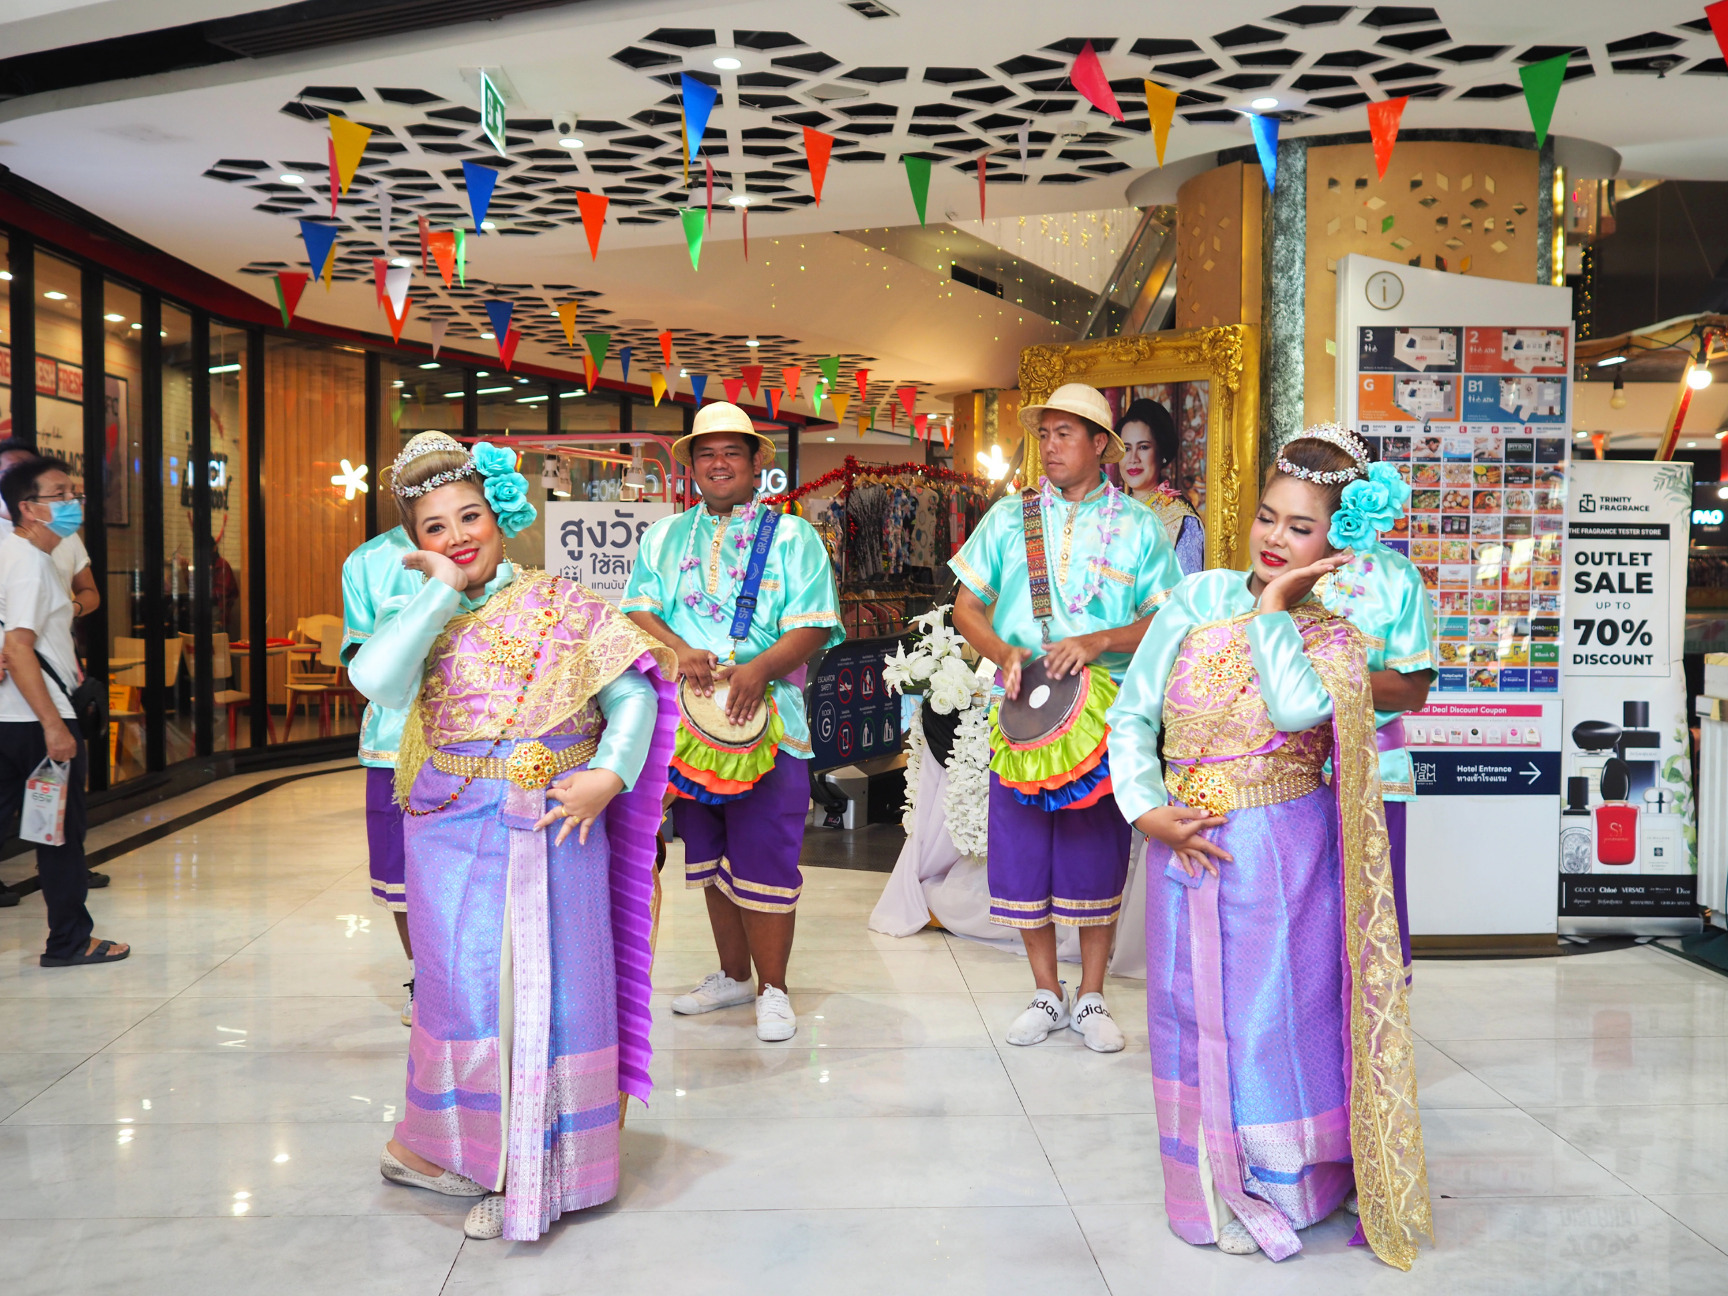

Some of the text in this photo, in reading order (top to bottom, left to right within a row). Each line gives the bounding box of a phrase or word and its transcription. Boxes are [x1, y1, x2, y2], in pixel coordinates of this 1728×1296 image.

[1364, 329, 1374, 342] 3
[1469, 331, 1479, 343] 2
[1363, 378, 1375, 391] G
[1467, 380, 1483, 393] B1
[1599, 504, 1650, 512] FRAGRANCE
[1693, 509, 1724, 525] PAO
[1581, 527, 1617, 535] FRAGRANCE
[1641, 528, 1661, 536] STORE
[756, 525, 772, 554] GRAND
[1574, 551, 1653, 566] OUTLET
[1574, 571, 1653, 594] SALE
[1595, 601, 1631, 610] UP TO
[1573, 618, 1653, 646] 70%
[1573, 654, 1654, 665] DISCOUNT
[820, 683, 832, 692] SAFETY
[821, 709, 831, 717] FLOOR
[1432, 705, 1447, 713] Deal
[1450, 705, 1478, 713] Discount
[1480, 706, 1507, 715] Coupon
[821, 717, 831, 737] G
[1457, 765, 1512, 773] Hotel Entrance
[1457, 773, 1507, 783] ทางเข้าโรงแรม
